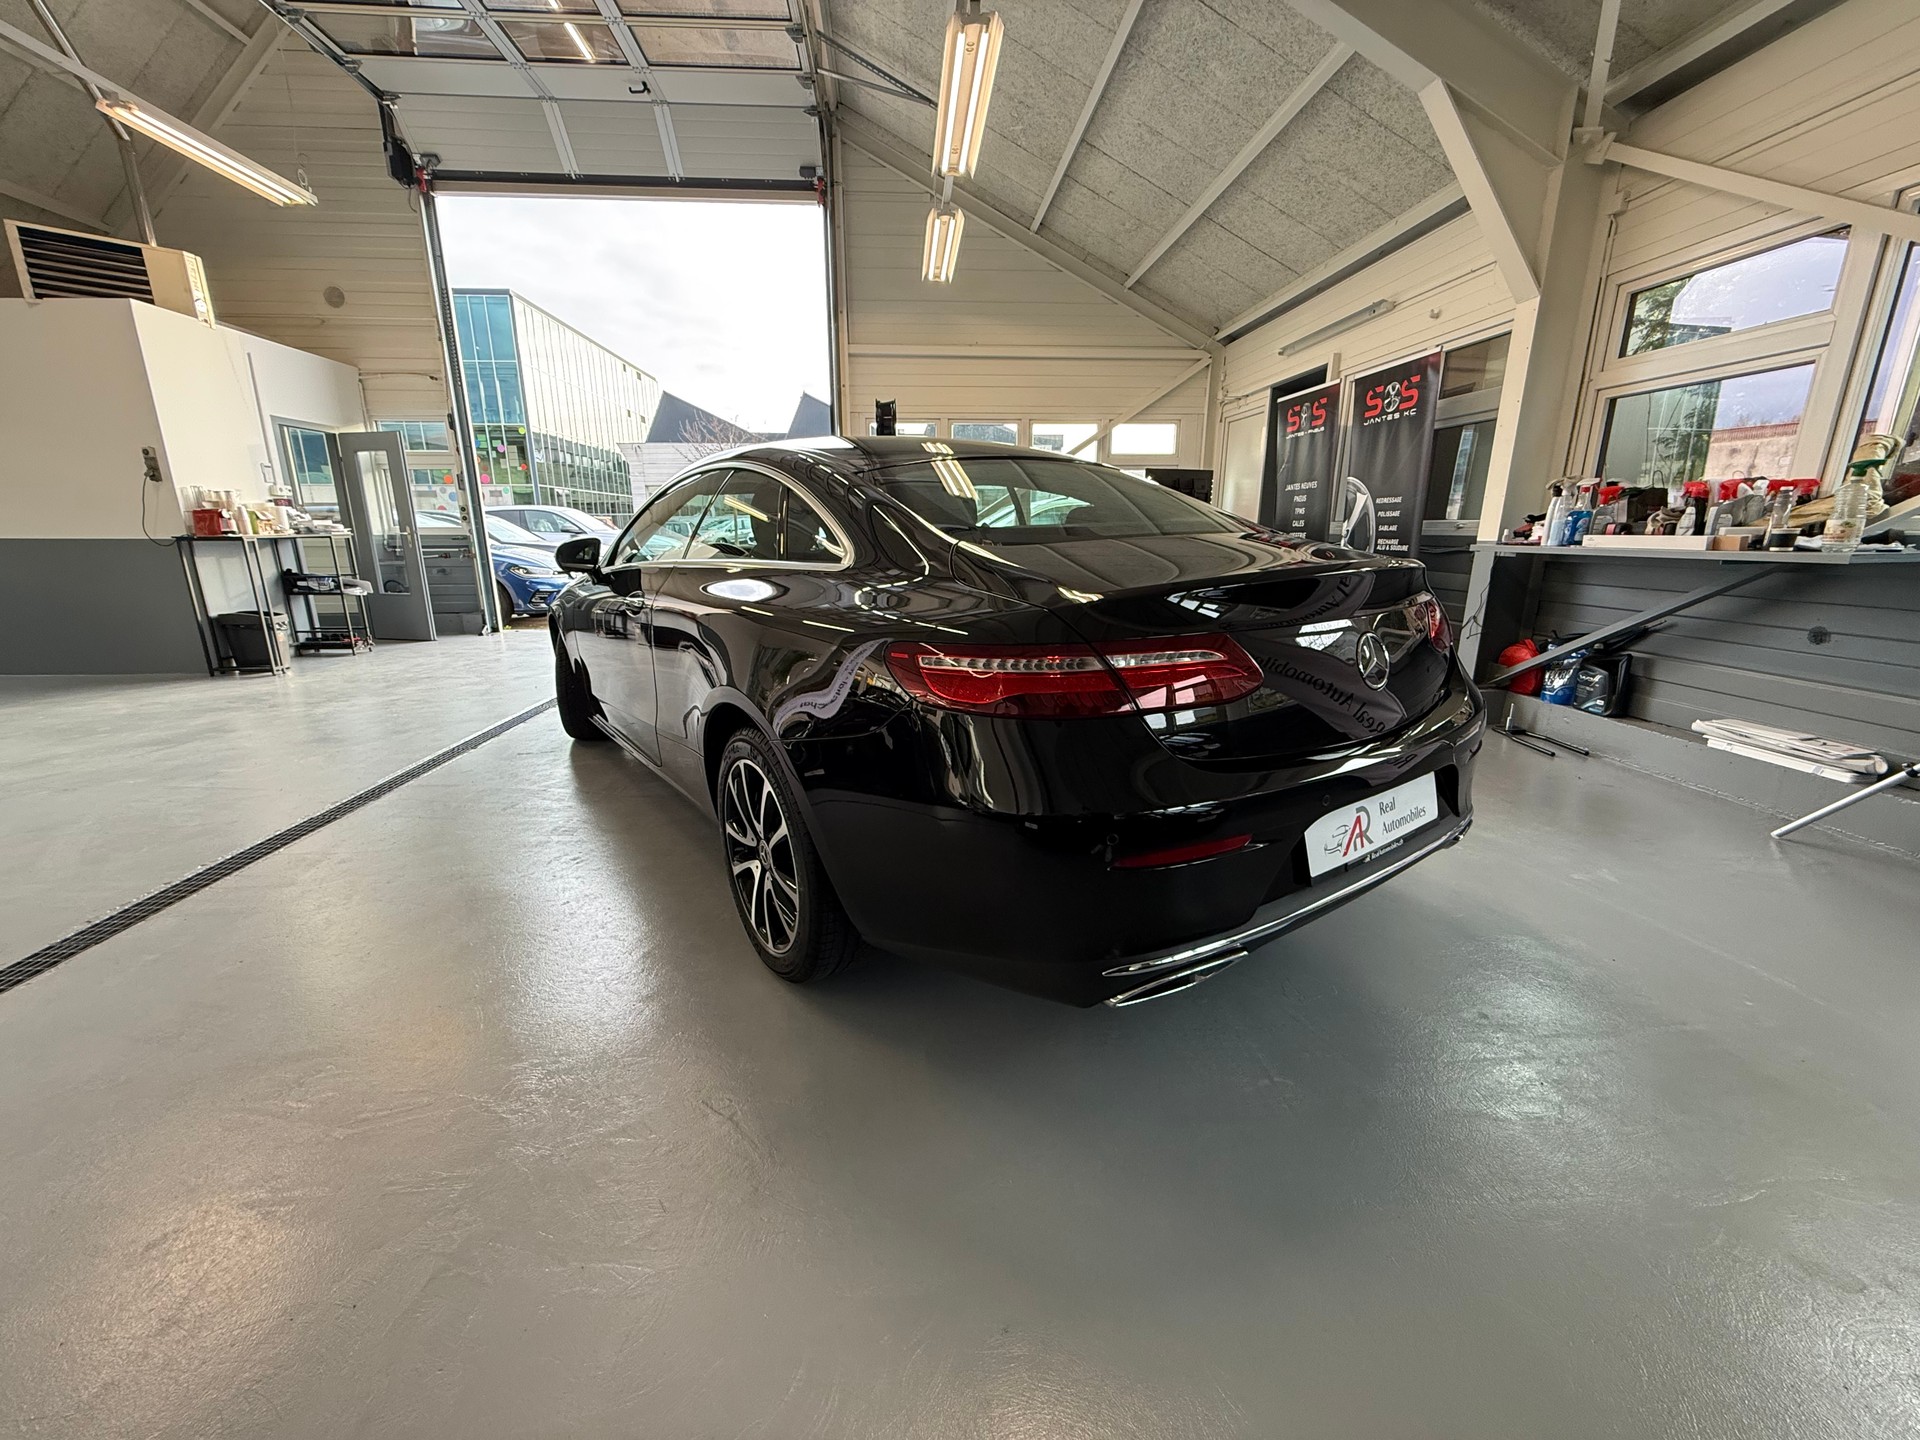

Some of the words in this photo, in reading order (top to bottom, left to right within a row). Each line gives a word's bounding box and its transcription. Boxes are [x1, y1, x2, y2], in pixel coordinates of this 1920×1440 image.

[1363, 412, 1400, 426] JANTES
[1403, 408, 1418, 417] KC
[1285, 483, 1301, 492] JANTES
[1301, 481, 1318, 490] NEUVES
[1375, 496, 1402, 504] REDRESSAGE
[1379, 796, 1397, 816] Real
[1382, 805, 1427, 836] Automobiles
